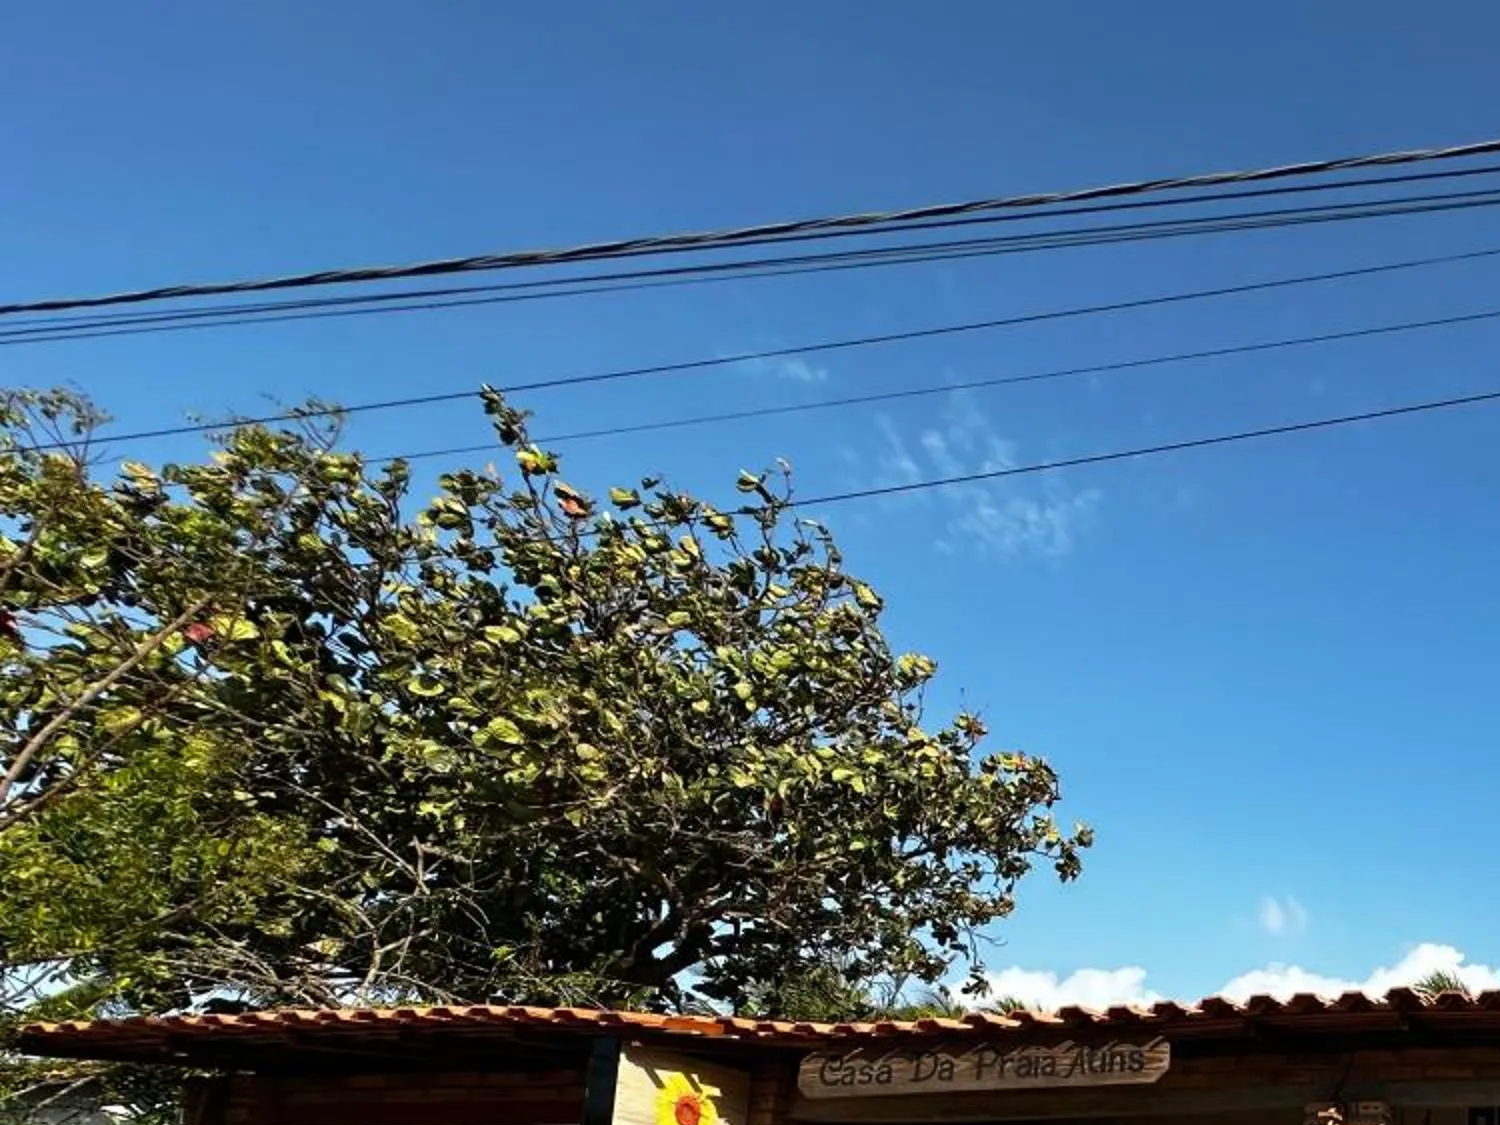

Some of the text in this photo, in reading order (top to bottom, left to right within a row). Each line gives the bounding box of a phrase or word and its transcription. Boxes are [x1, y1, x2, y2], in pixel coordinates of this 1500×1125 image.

[819, 1045, 1145, 1086] Casa Da Praia Atins
